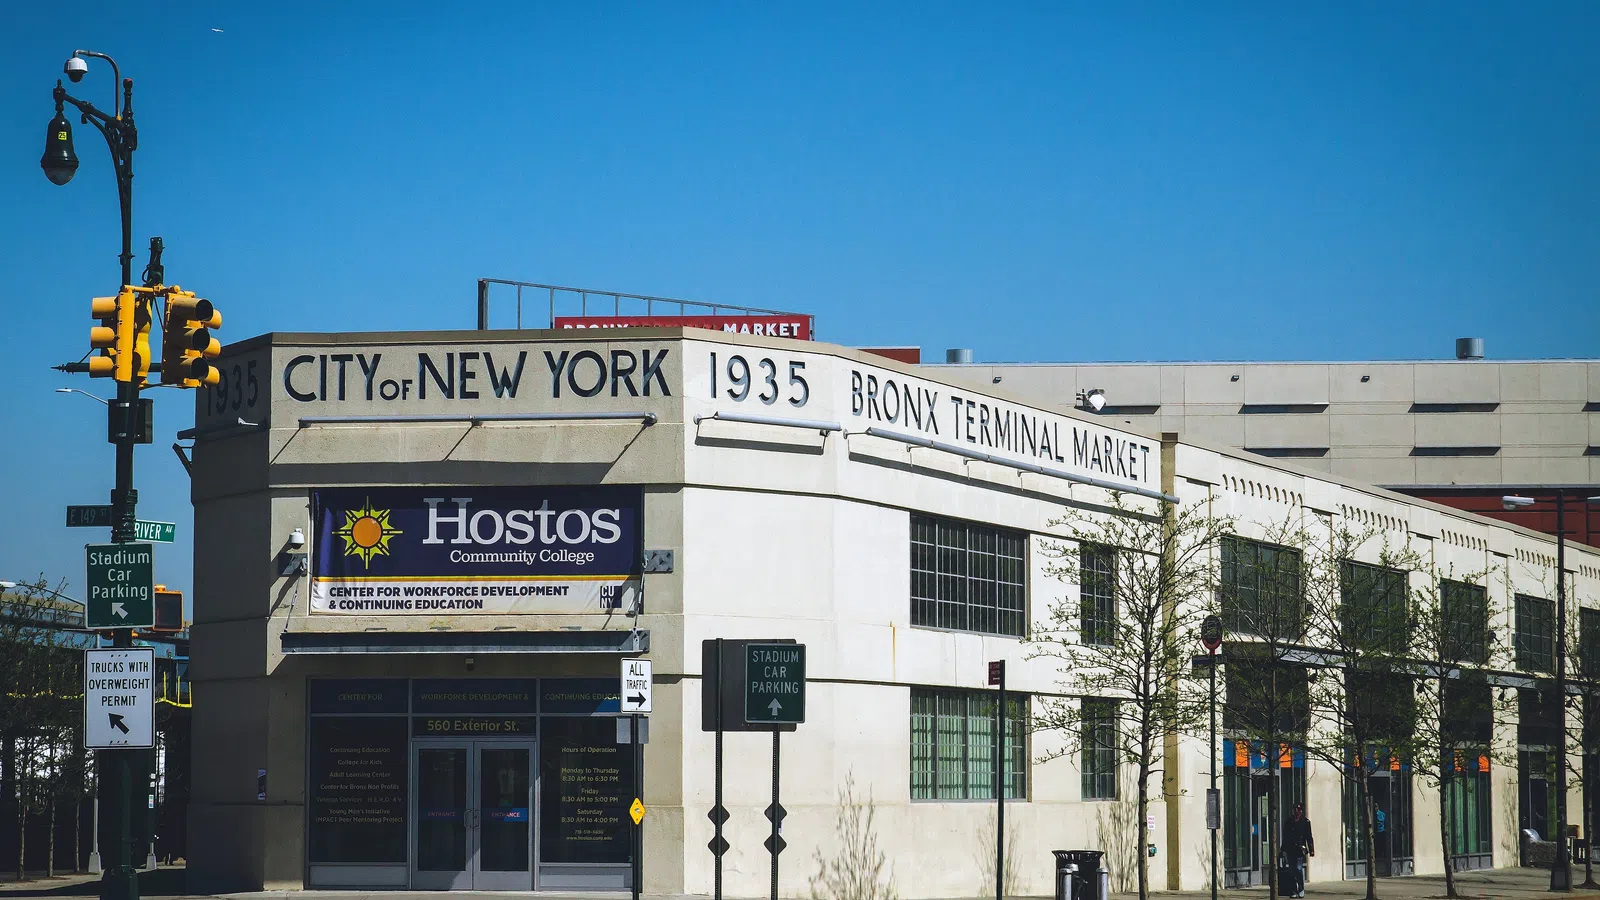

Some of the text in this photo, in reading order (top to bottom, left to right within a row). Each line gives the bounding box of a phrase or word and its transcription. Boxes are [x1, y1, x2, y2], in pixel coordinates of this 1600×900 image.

[723, 323, 800, 336] MARKET
[283, 349, 671, 402] CITY OF NEW YORK
[710, 352, 810, 408] 1935
[208, 360, 258, 416] 1935
[851, 369, 1150, 483] BRONX TERMINAL MARKET
[70, 508, 76, 524] E
[80, 508, 96, 524] 149
[134, 522, 161, 540] RIVER
[90, 550, 150, 566] Stadium
[450, 550, 594, 565] Community College
[108, 568, 132, 581] Car
[92, 584, 148, 600] Parking
[329, 586, 569, 597] CENTER FOR WORKFORCE DEVELOPMENT
[328, 599, 483, 610] & CONTINUING EDUCATION
[752, 650, 799, 662] STADIUM
[91, 662, 148, 672] TRUCKS WITH
[629, 664, 644, 676] ALL
[764, 666, 787, 678] CAR
[89, 679, 150, 690] OVERWEIGHT
[627, 680, 647, 690] TRAFFIC
[752, 682, 799, 693] PARKING
[101, 696, 137, 706] PERMIT
[428, 720, 520, 731] 560 Exterior St.
